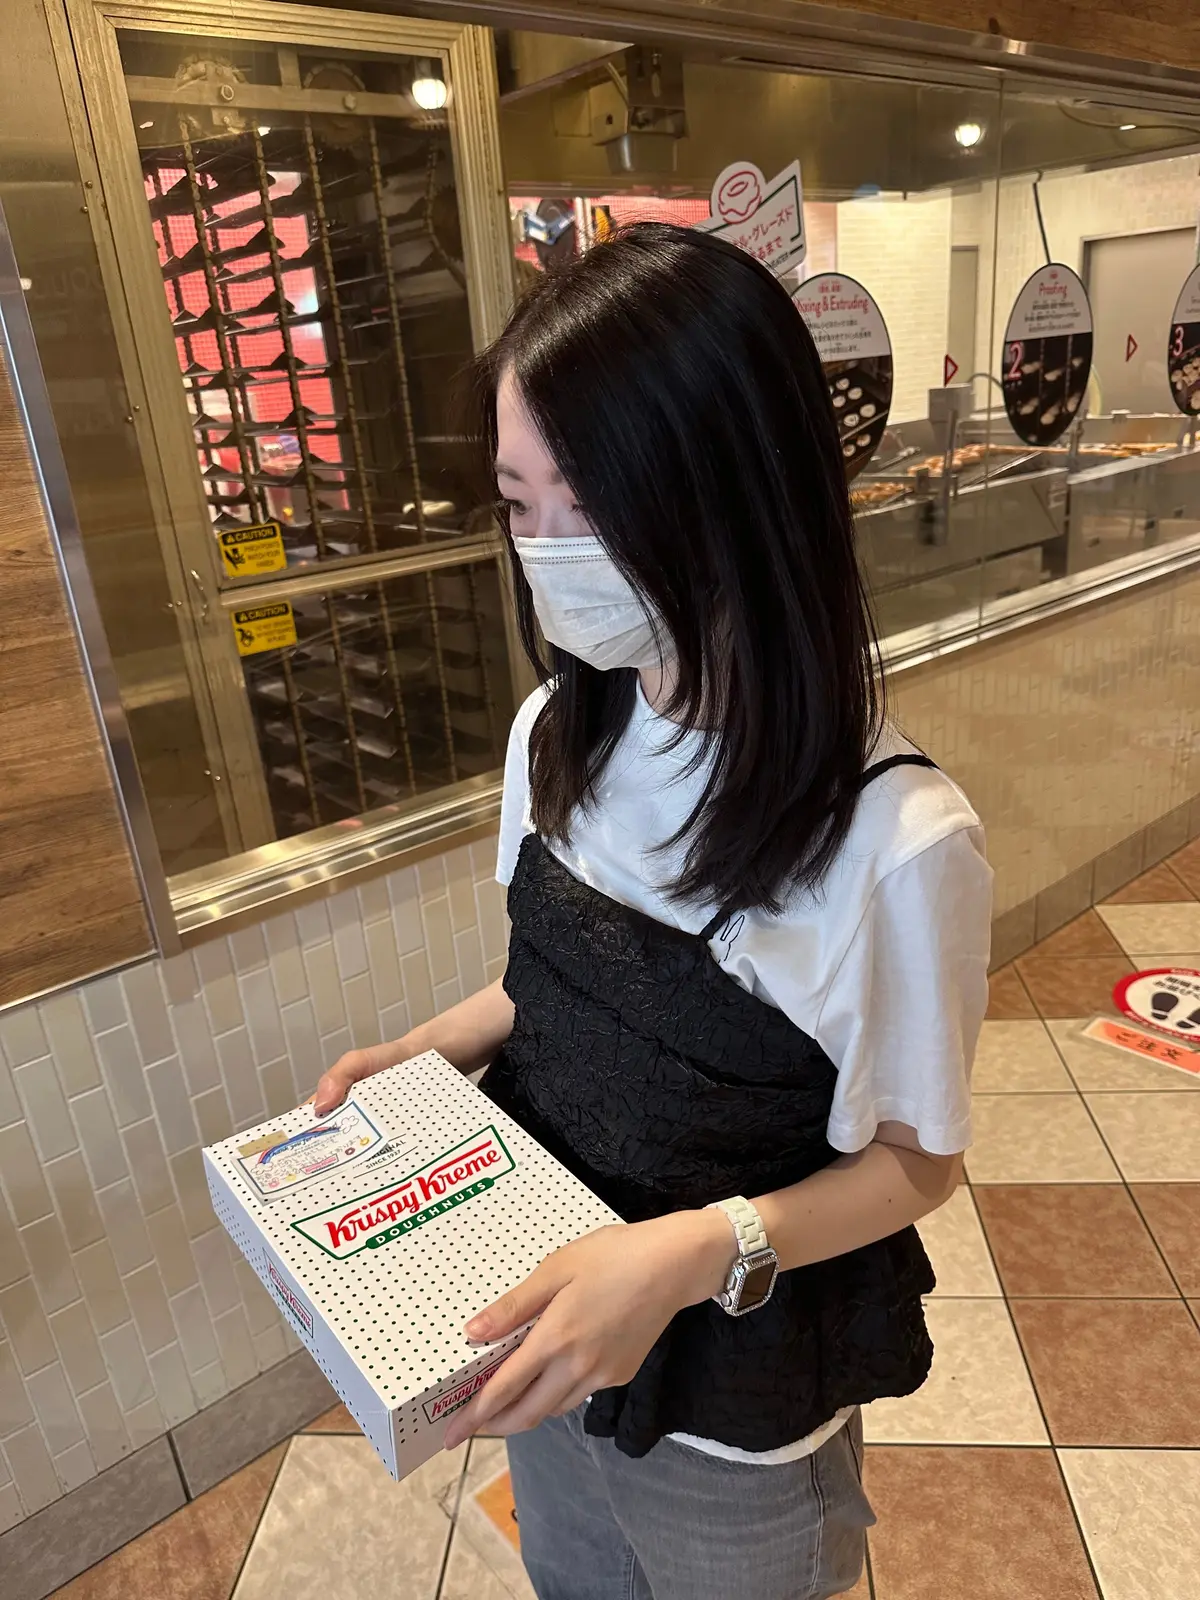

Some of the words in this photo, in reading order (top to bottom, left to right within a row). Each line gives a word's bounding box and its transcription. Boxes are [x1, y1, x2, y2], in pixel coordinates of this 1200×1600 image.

[1038, 282, 1068, 299] Proofing
[830, 294, 869, 314] Extruding
[1172, 325, 1185, 357] 3
[1008, 340, 1024, 380] 2
[235, 527, 275, 542] CAUTION
[248, 604, 286, 619] CAUTION
[365, 1156, 387, 1169] SINCE
[387, 1149, 401, 1159] 1937
[323, 1181, 422, 1249] Krispy
[415, 1139, 502, 1202] Kreme
[375, 1181, 487, 1246] DOUGHNUTS
[431, 1378, 475, 1418] Krispy
